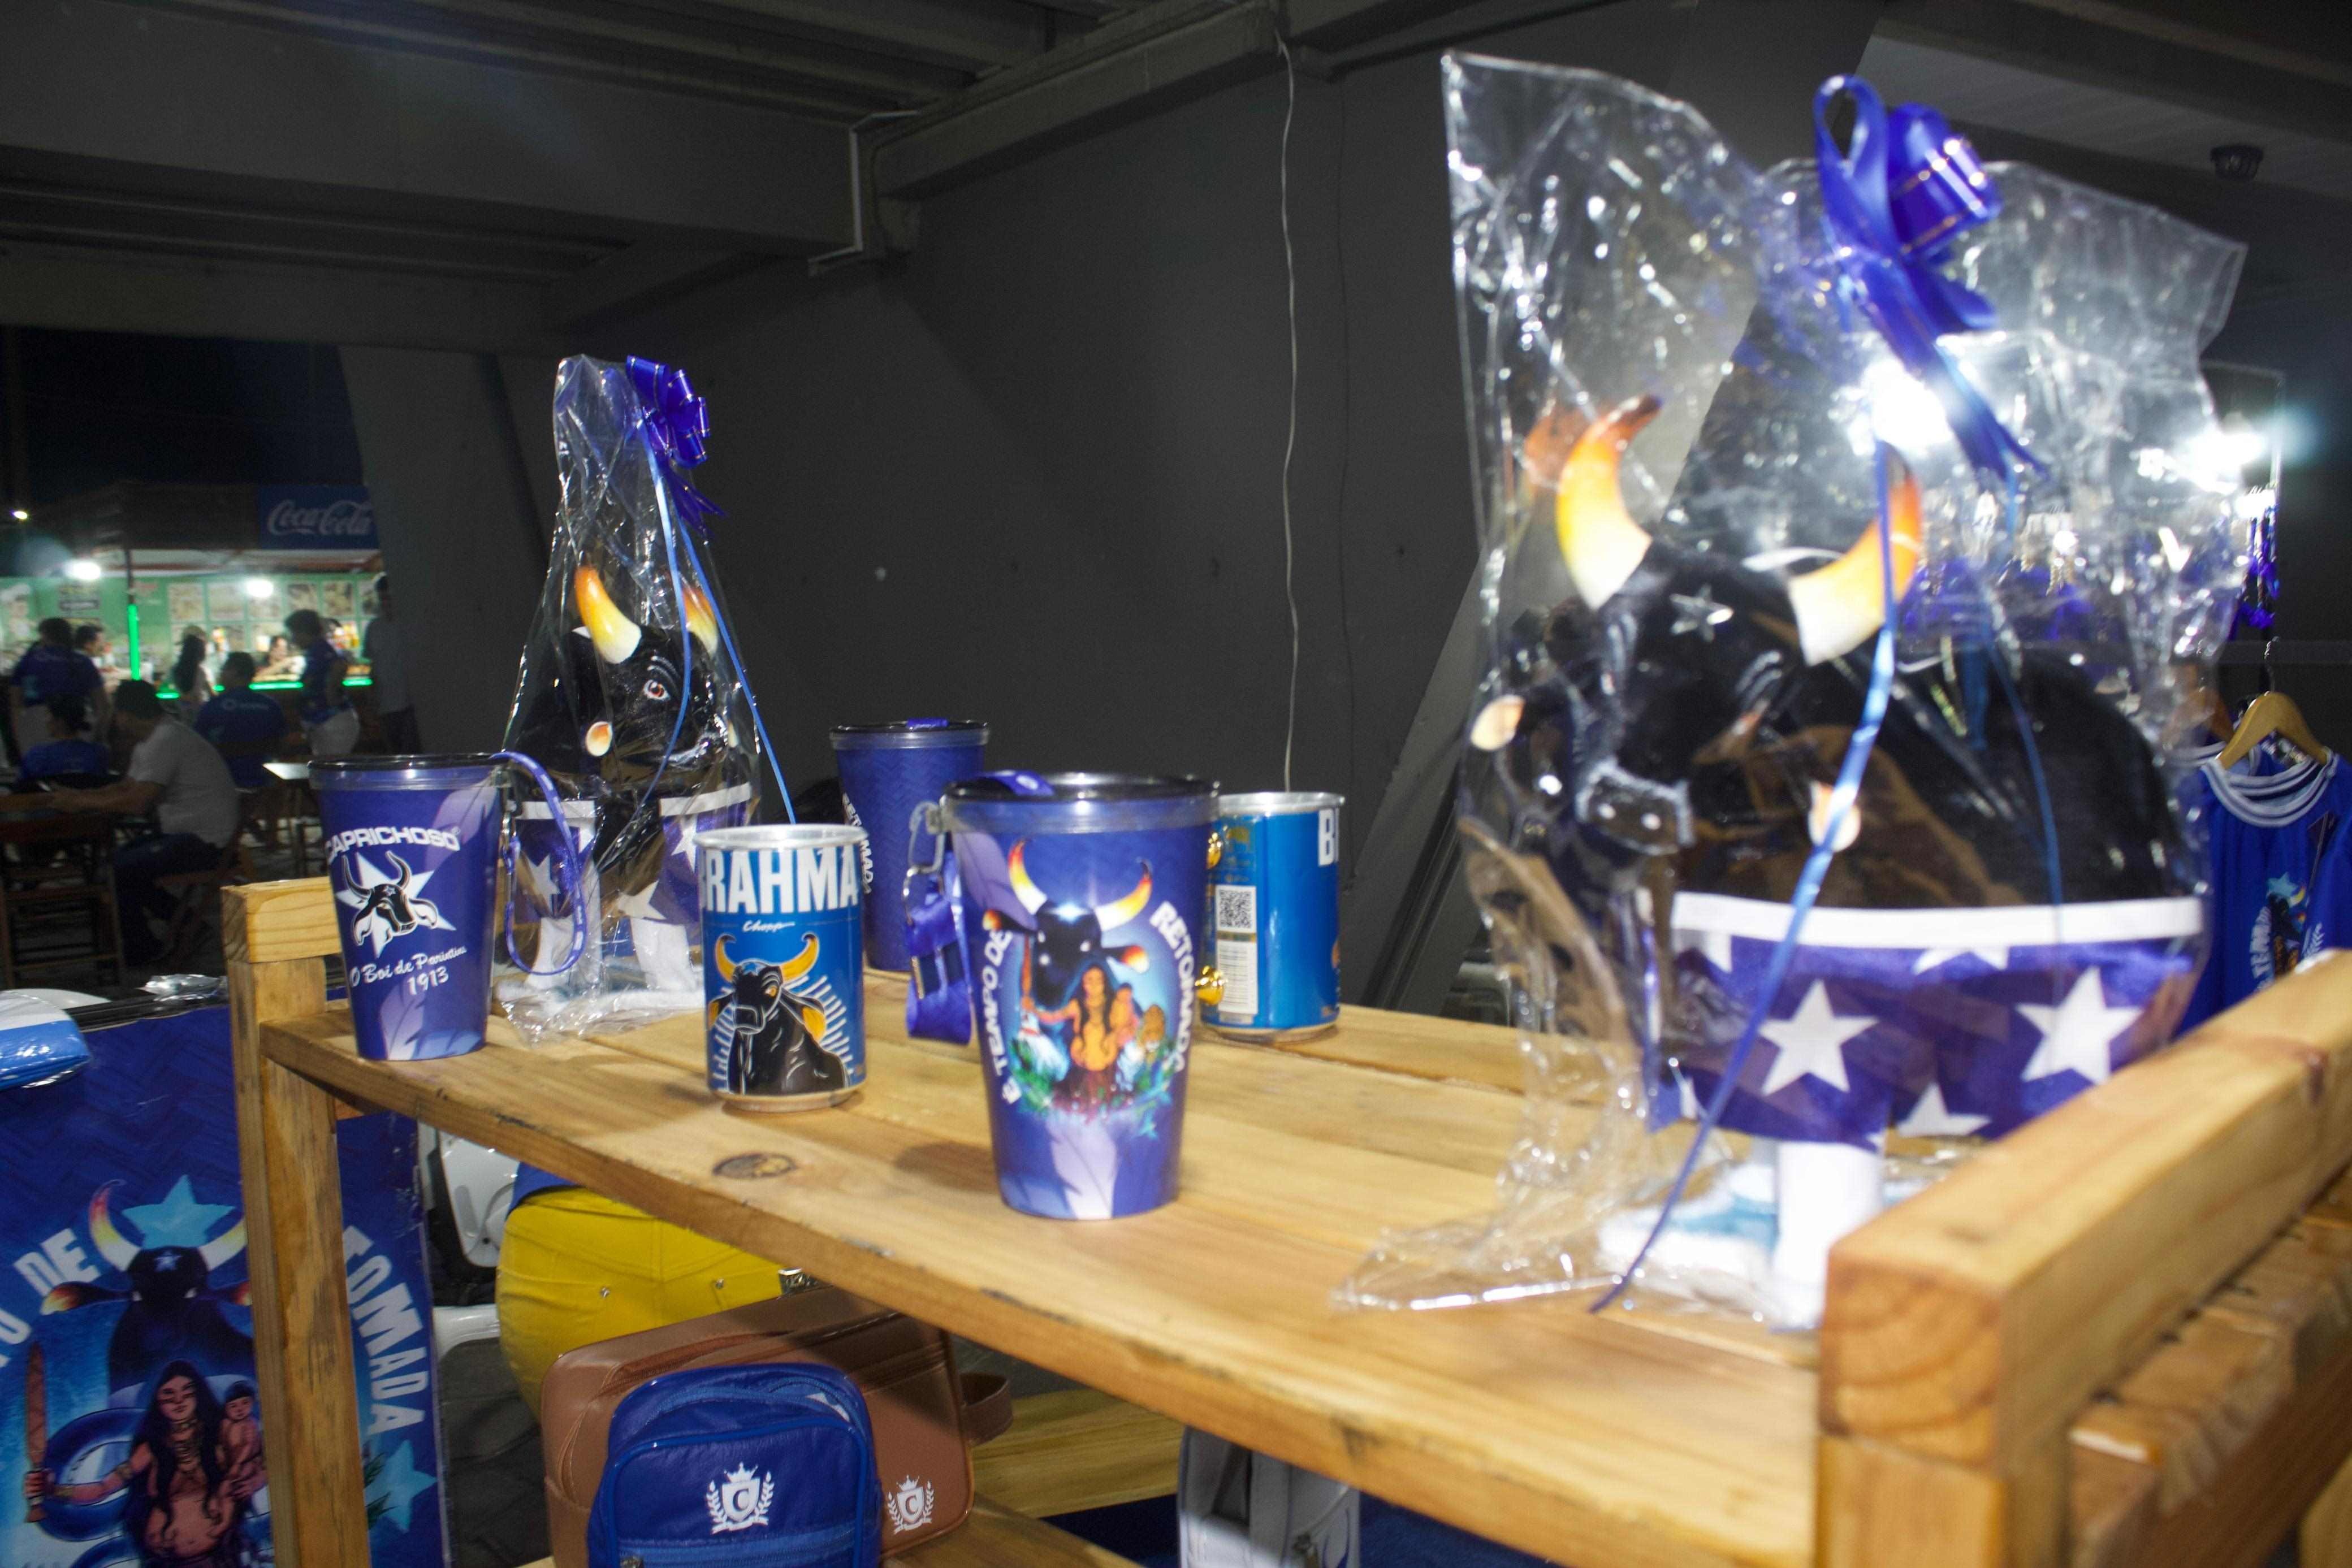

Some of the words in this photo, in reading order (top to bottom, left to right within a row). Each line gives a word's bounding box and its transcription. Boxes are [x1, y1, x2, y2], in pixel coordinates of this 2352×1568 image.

[349, 966, 361, 988] O
[361, 963, 393, 984] Boi
[394, 959, 415, 975] de
[407, 965, 449, 995] 1913
[982, 966, 1008, 1076] TEMPO
[13, 1227, 102, 1297] DE
[732, 1487, 750, 1512] C
[905, 1495, 918, 1514] C
